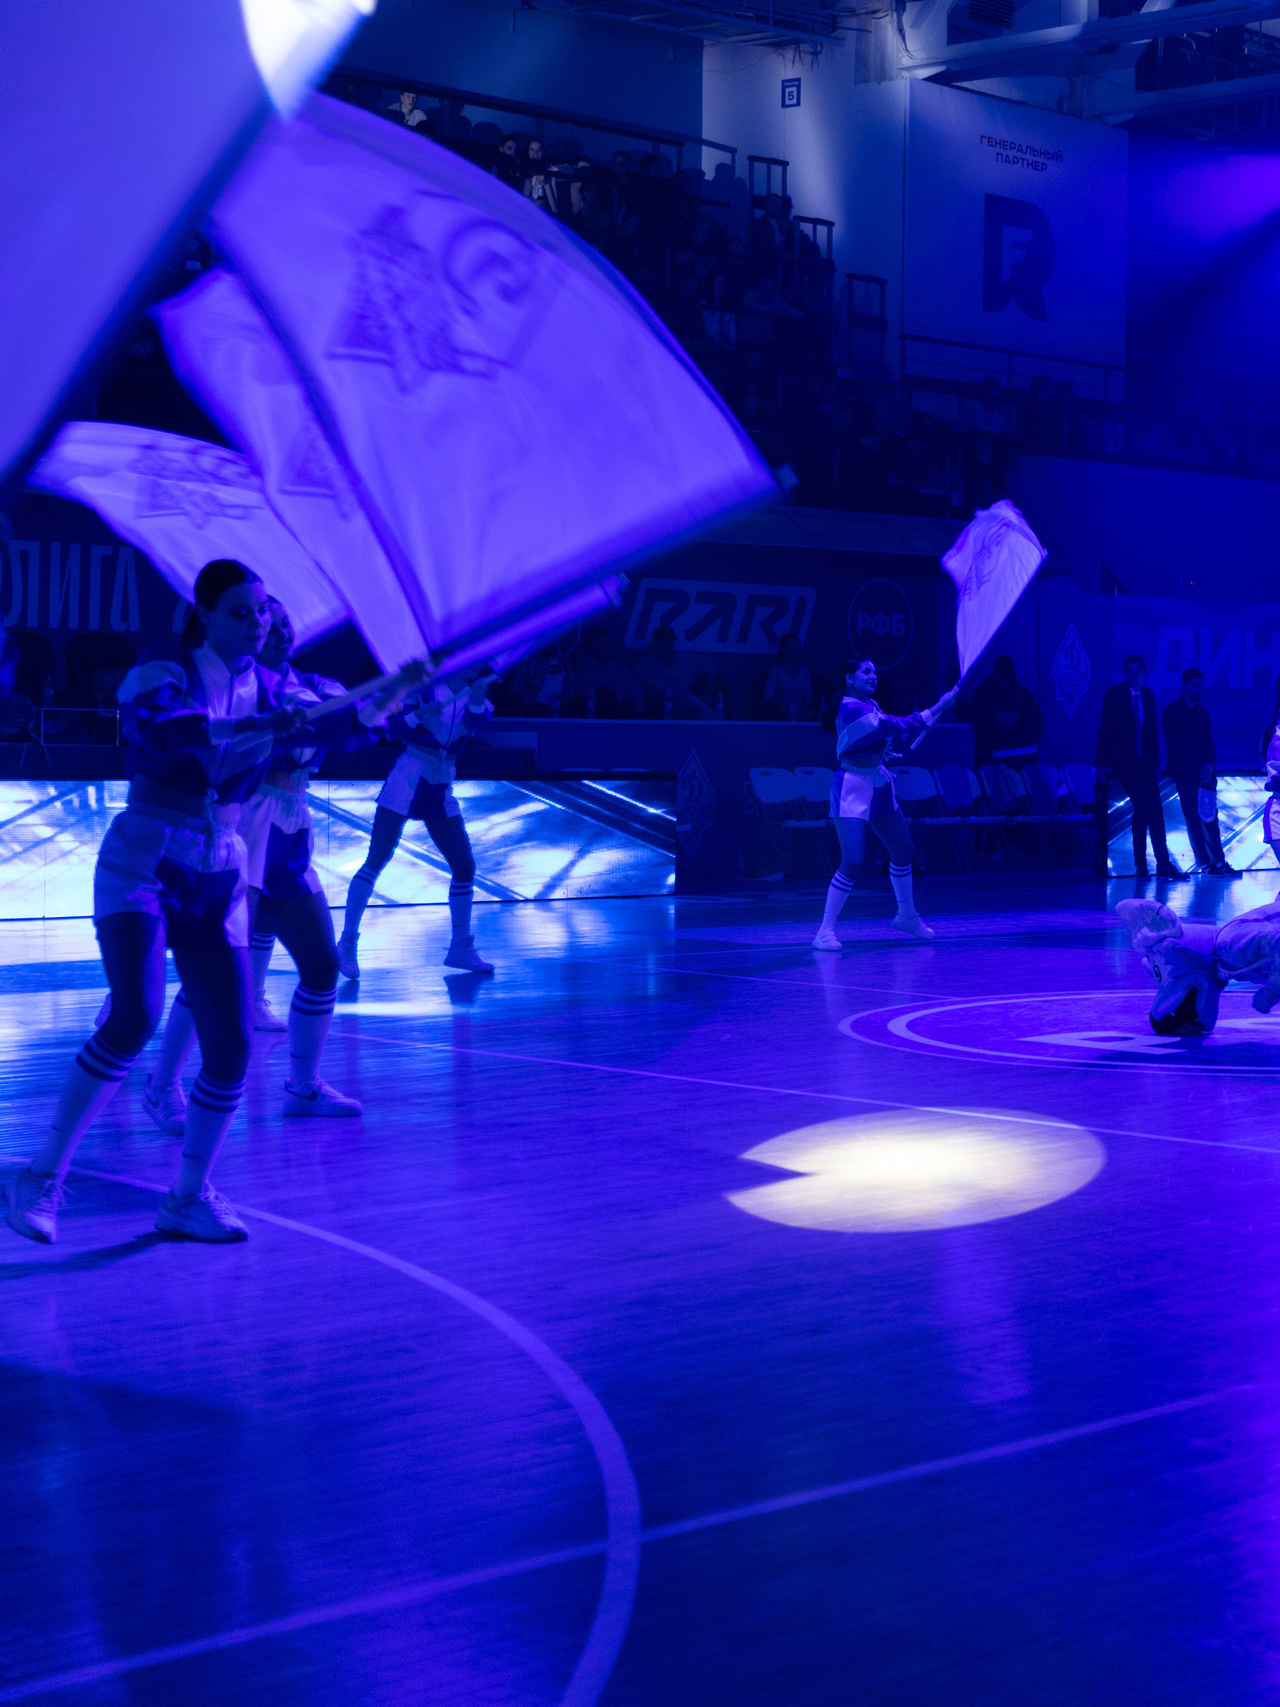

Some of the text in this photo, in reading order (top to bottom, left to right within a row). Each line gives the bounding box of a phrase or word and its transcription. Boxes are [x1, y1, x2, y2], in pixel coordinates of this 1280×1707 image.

[787, 91, 795, 101] 5
[979, 134, 1064, 163] ГЕНЕРАЛЬНЫЙ
[995, 151, 1049, 172] ПАРТНЕР
[0, 539, 141, 632] ЛИГА
[633, 588, 808, 645] PARI
[856, 611, 905, 637] РФБ
